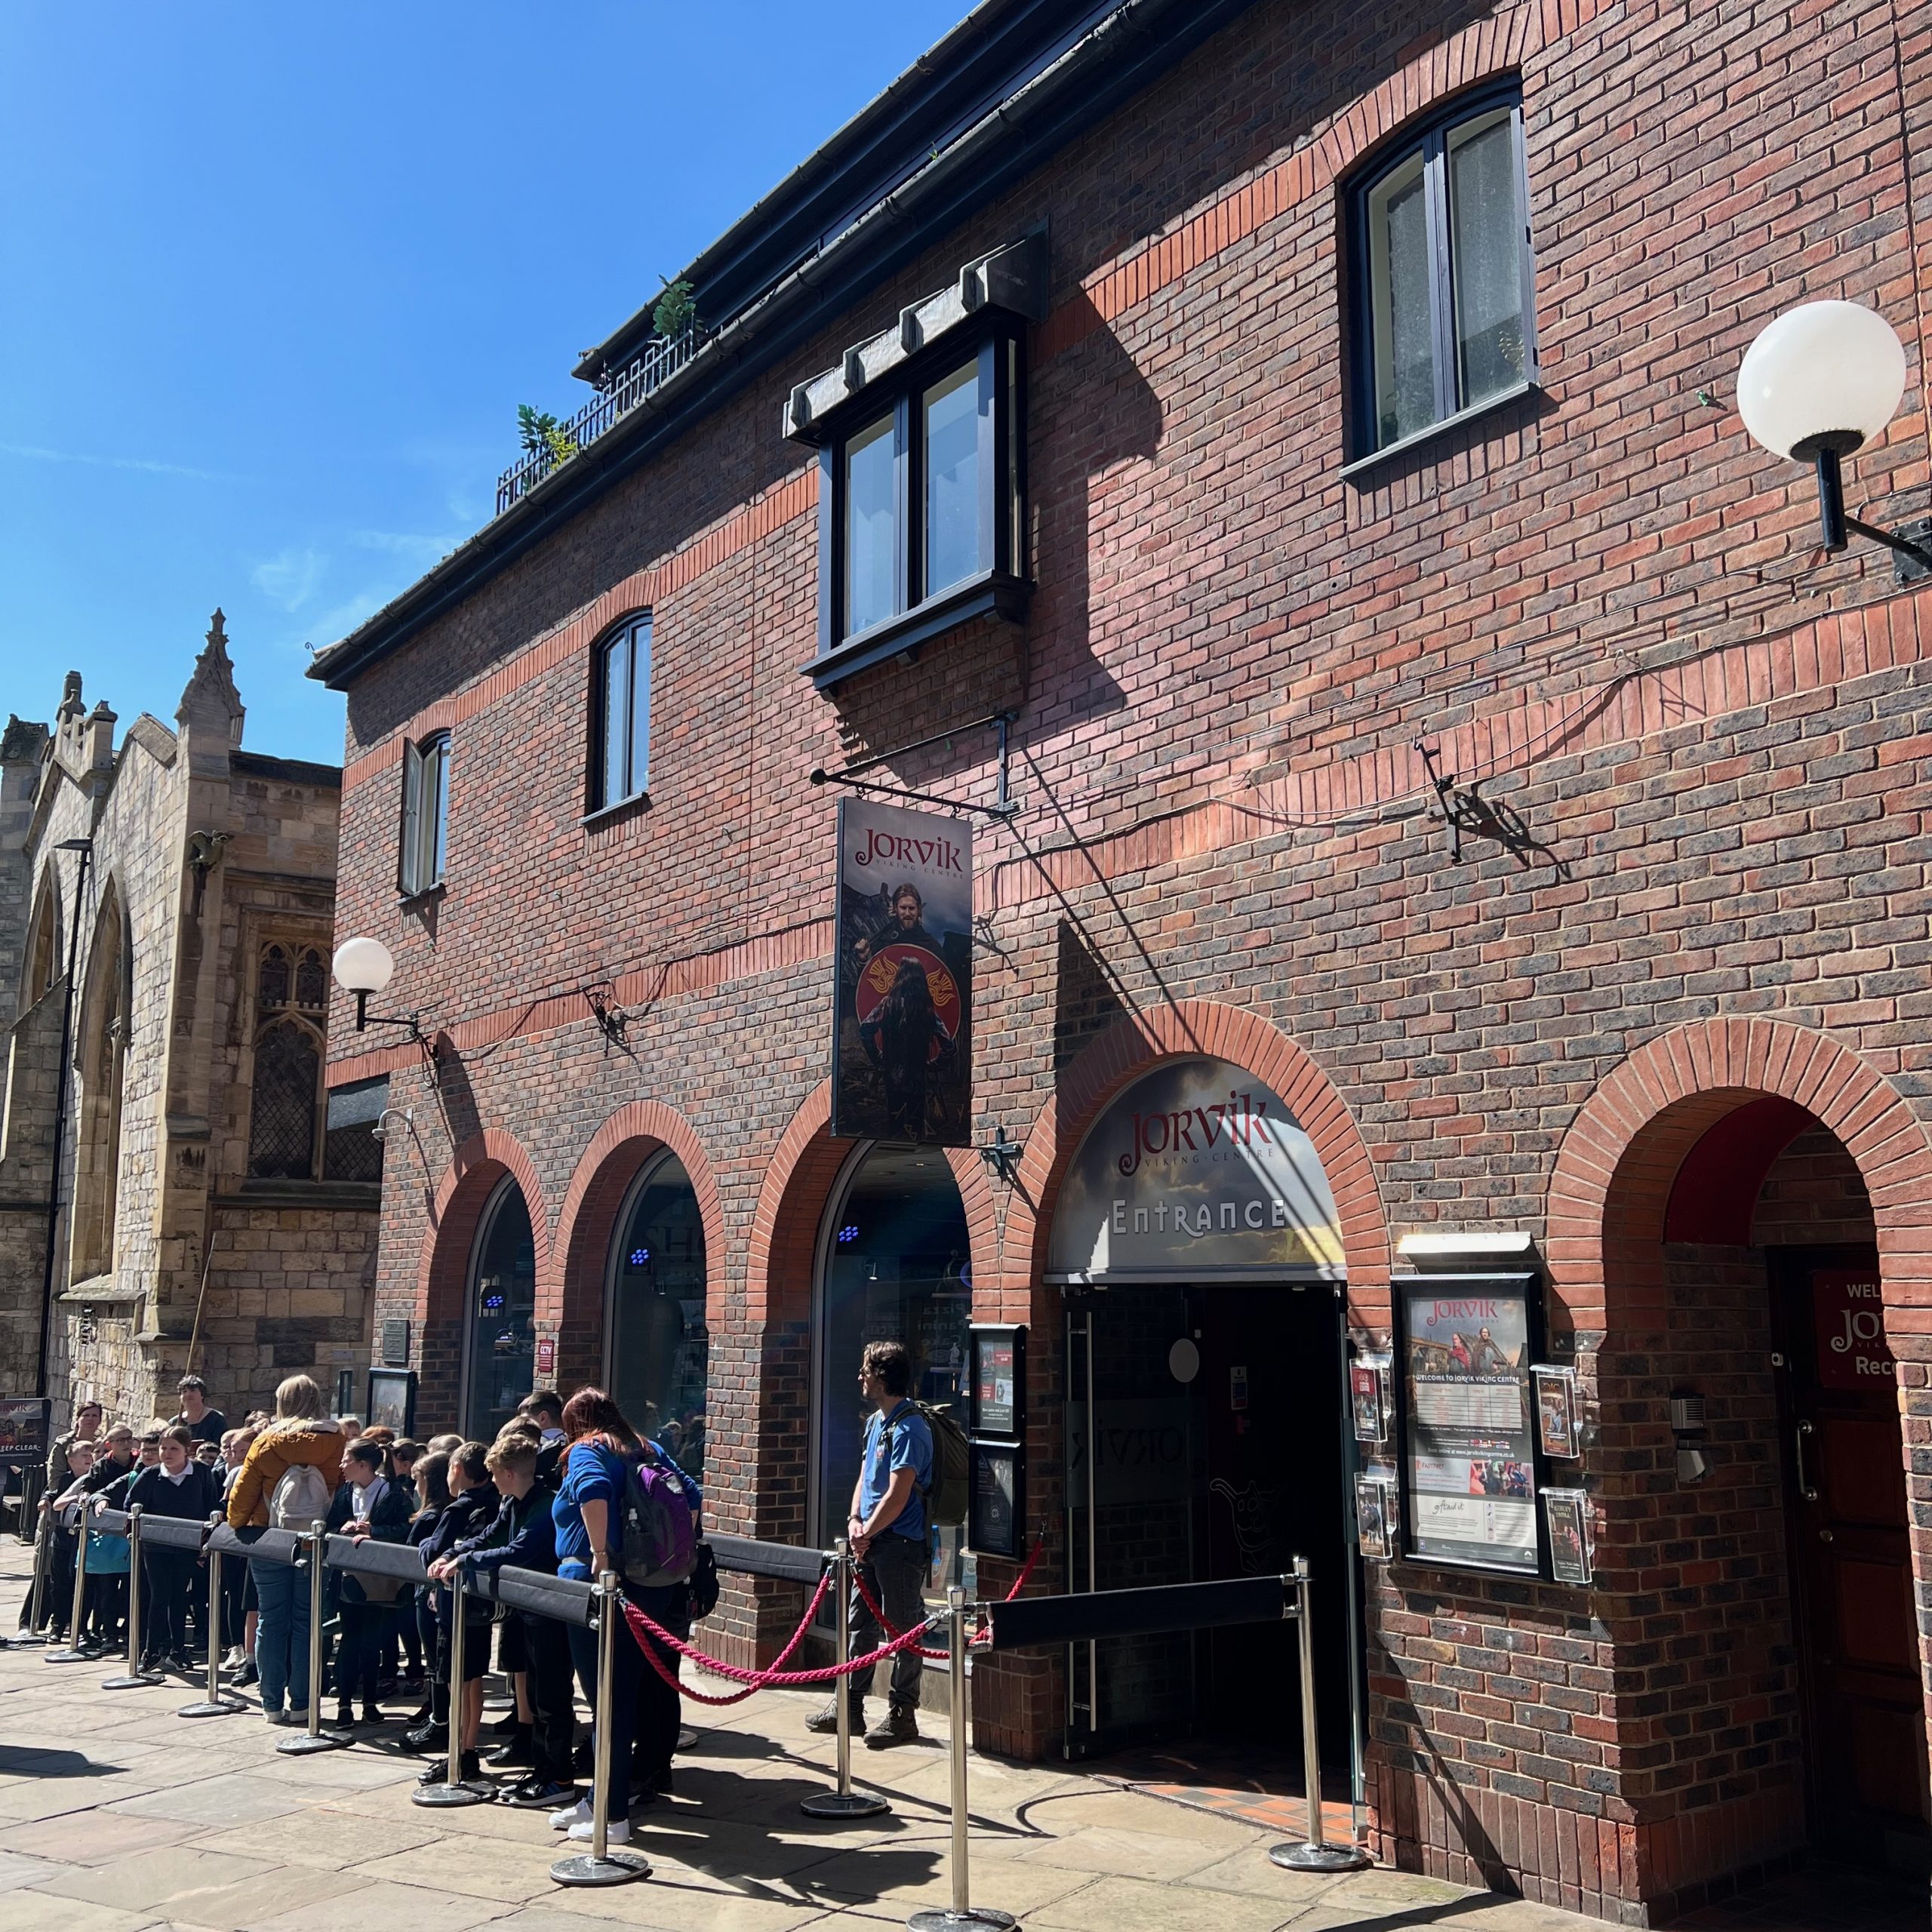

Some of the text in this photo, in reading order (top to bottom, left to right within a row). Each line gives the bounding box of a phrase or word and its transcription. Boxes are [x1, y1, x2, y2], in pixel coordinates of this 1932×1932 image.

[855, 828, 963, 872] JORVIK
[875, 859, 964, 879] VIKING CENTRE
[1118, 1090, 1272, 1177] JORVIK
[1144, 1148, 1274, 1168] VIKING CENTRE
[1427, 1299, 1498, 1326] JORVIK
[1830, 1309, 1883, 1352] JO
[540, 1346, 552, 1355] CCTV
[1497, 1376, 1519, 1384] CENTRE
